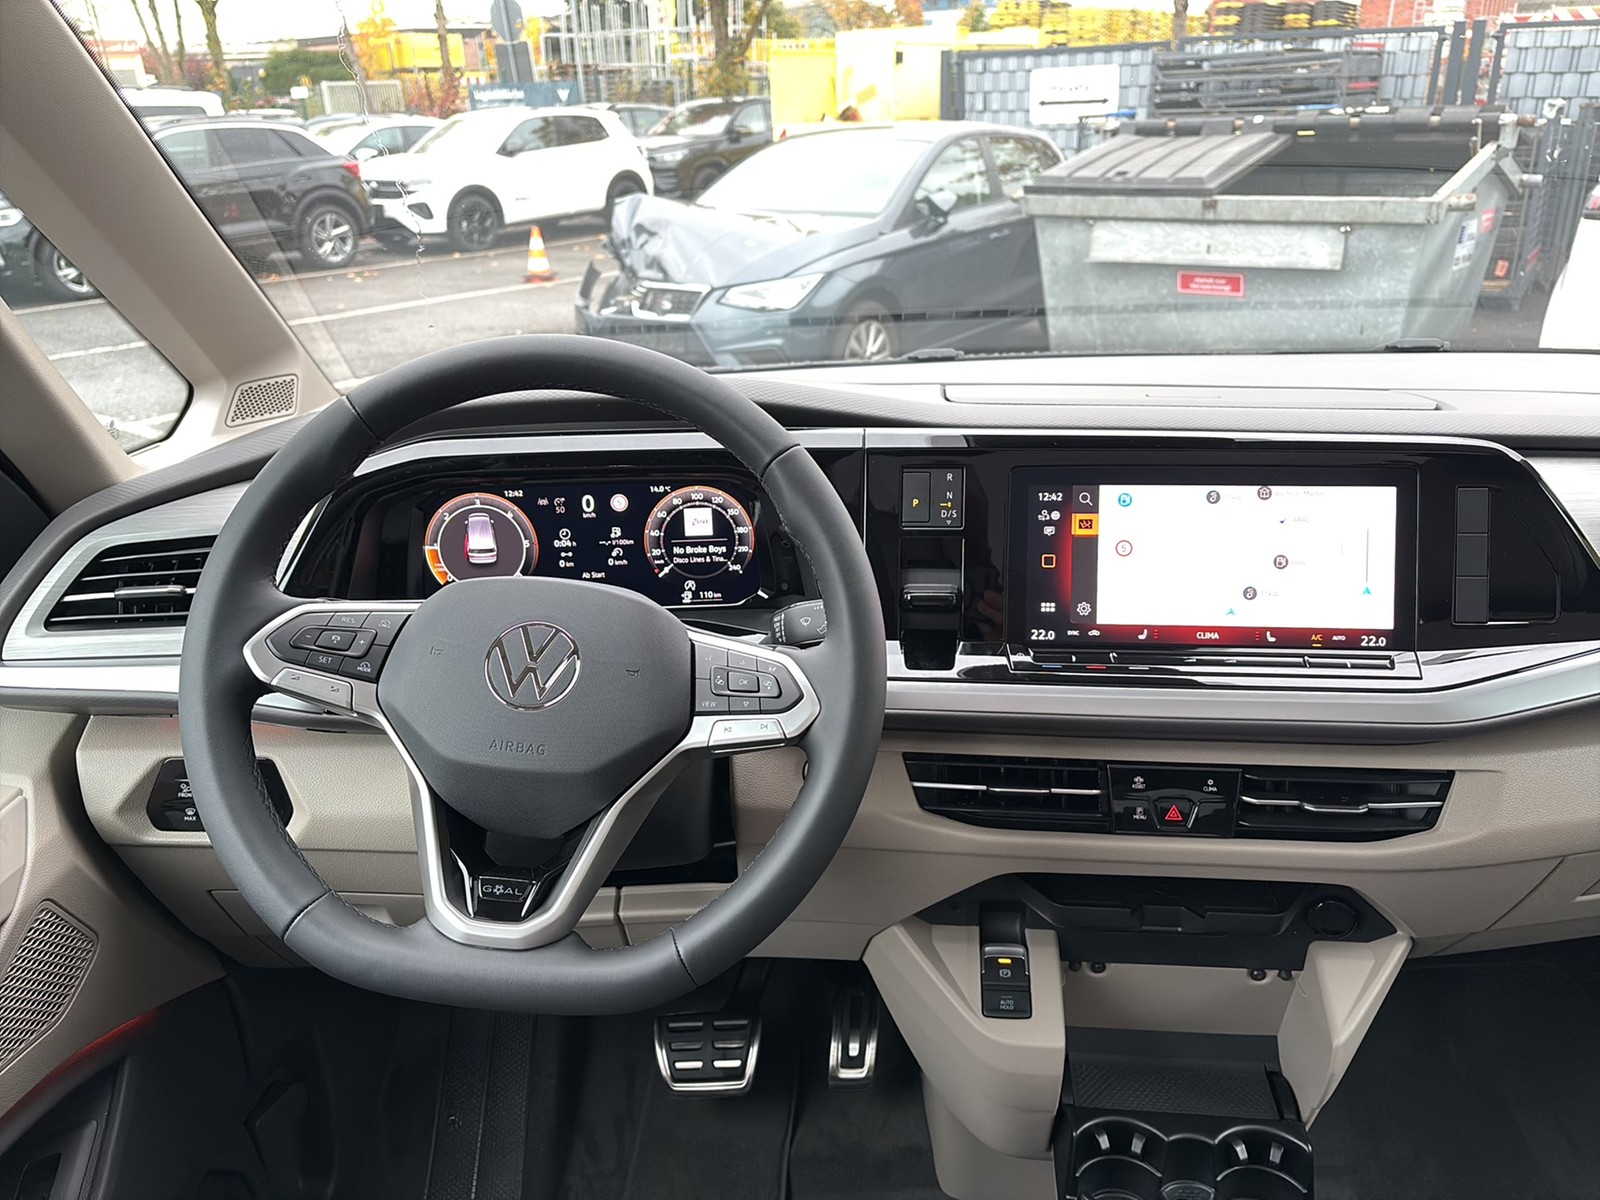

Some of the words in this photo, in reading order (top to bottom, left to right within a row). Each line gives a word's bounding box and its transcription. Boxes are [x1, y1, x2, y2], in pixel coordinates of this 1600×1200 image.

[947, 473, 953, 481] R
[504, 490, 524, 498] 12:42
[1038, 492, 1063, 502] 12:42
[581, 494, 595, 513] 0
[672, 497, 683, 505] 80
[711, 496, 724, 504] 120
[912, 499, 919, 507] P
[555, 506, 566, 514] 50
[656, 510, 667, 518] 60
[727, 508, 740, 516] 150
[940, 509, 957, 518] D/S
[649, 529, 660, 537] 40
[553, 540, 572, 548] 0:04
[1121, 544, 1127, 552] 5
[673, 546, 684, 554] No
[685, 546, 707, 554] Broke
[708, 545, 727, 554] Boys
[559, 559, 565, 568] 0
[608, 558, 614, 566] 0
[729, 563, 742, 572] 240
[582, 571, 591, 579] Ab
[1030, 629, 1055, 640] 22.0
[1196, 631, 1220, 640] CLIMA
[1360, 635, 1386, 647] 22.0
[318, 656, 332, 664] SET
[488, 739, 547, 756] AIRBAG
